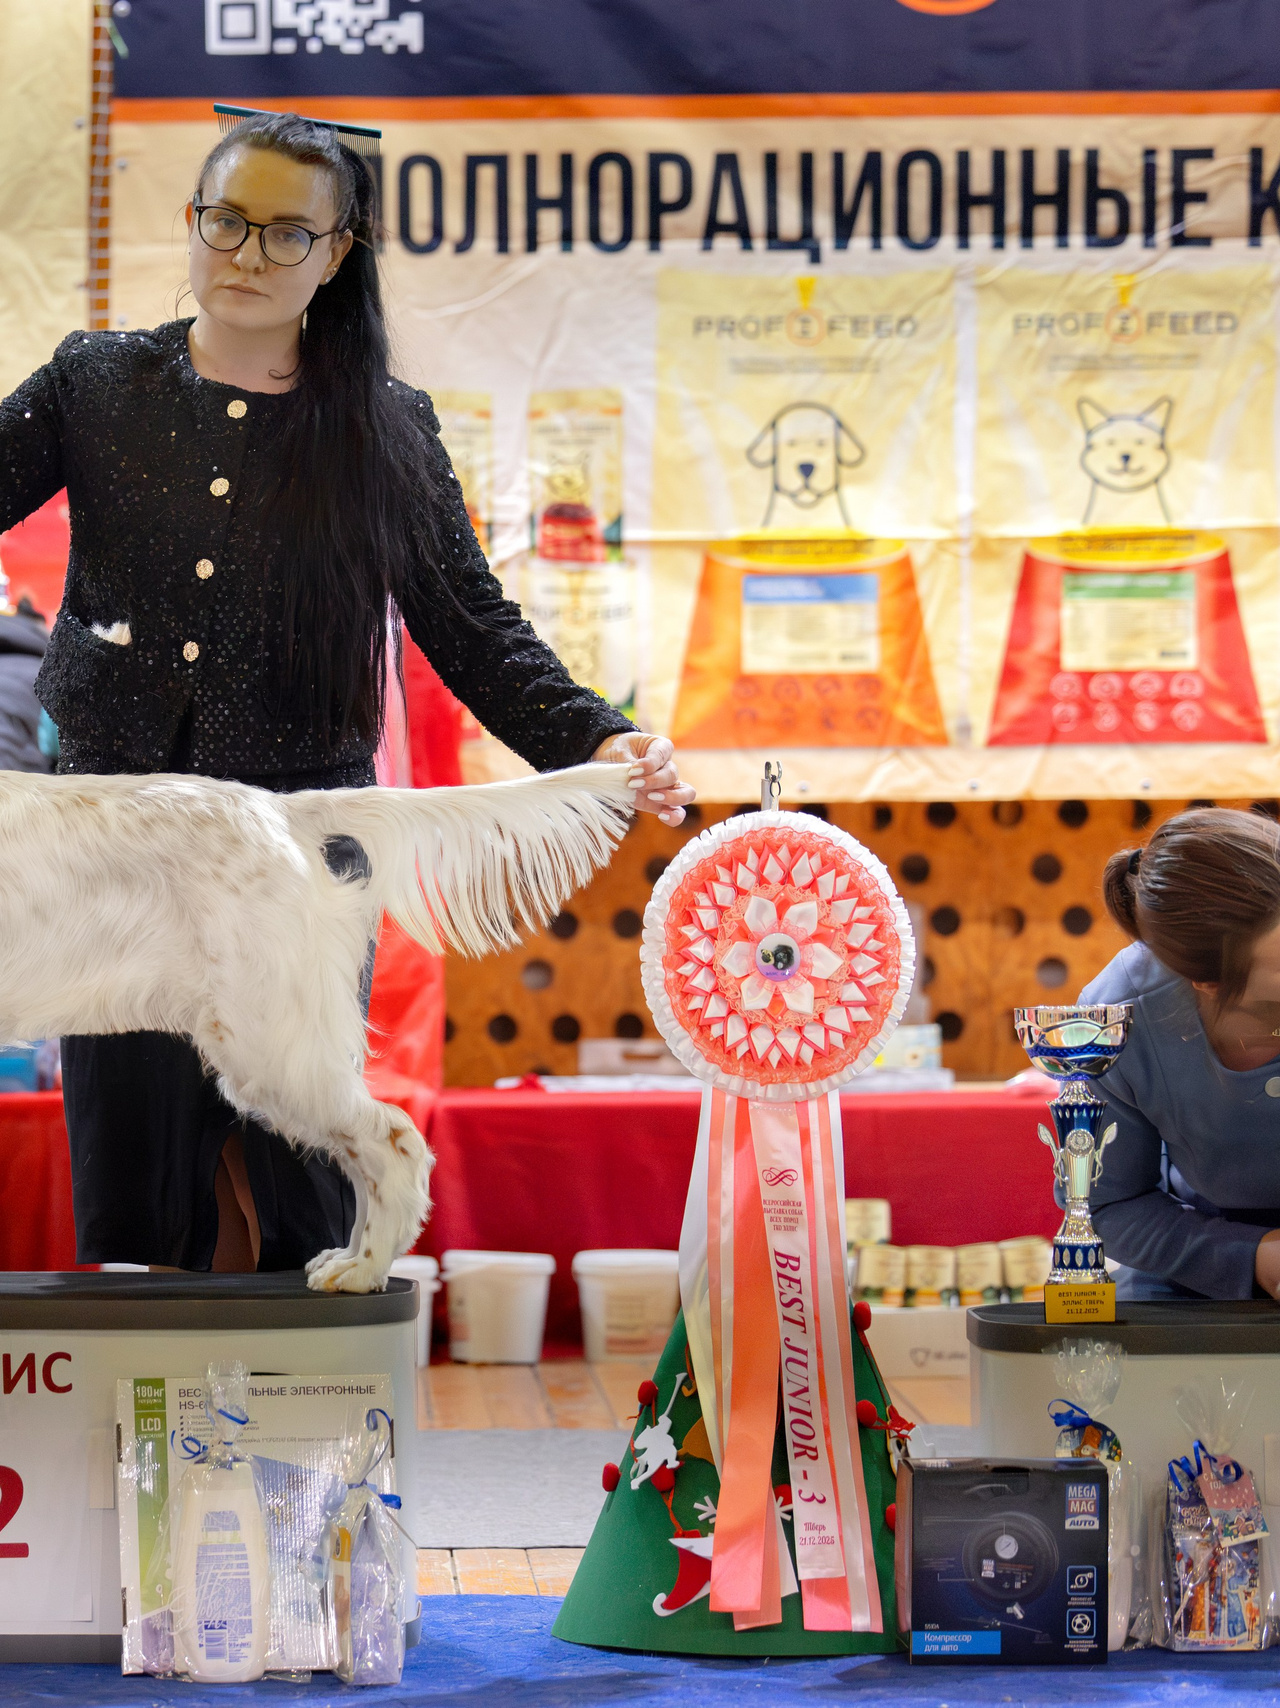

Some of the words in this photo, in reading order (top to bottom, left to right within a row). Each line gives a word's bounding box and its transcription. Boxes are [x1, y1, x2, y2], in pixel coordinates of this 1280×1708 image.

[372, 147, 1214, 263] ОЛНОРАЦИОННЫЕ
[774, 1248, 807, 1335] BEST
[290, 1385, 377, 1396] ЭЛЕКТРОННЫЕ
[783, 1336, 819, 1462] JUNIOR
[141, 1418, 162, 1432] LCD
[798, 1489, 826, 1504] 3
[1068, 1485, 1097, 1498] MEGA
[1070, 1500, 1095, 1513] MAG
[804, 1522, 827, 1534] Тверь
[1070, 1519, 1095, 1527] AUTO
[799, 1536, 835, 1546] 21.12.2025
[924, 1633, 972, 1643] Компрессор
[924, 1644, 939, 1652] для
[940, 1644, 959, 1652] авто
